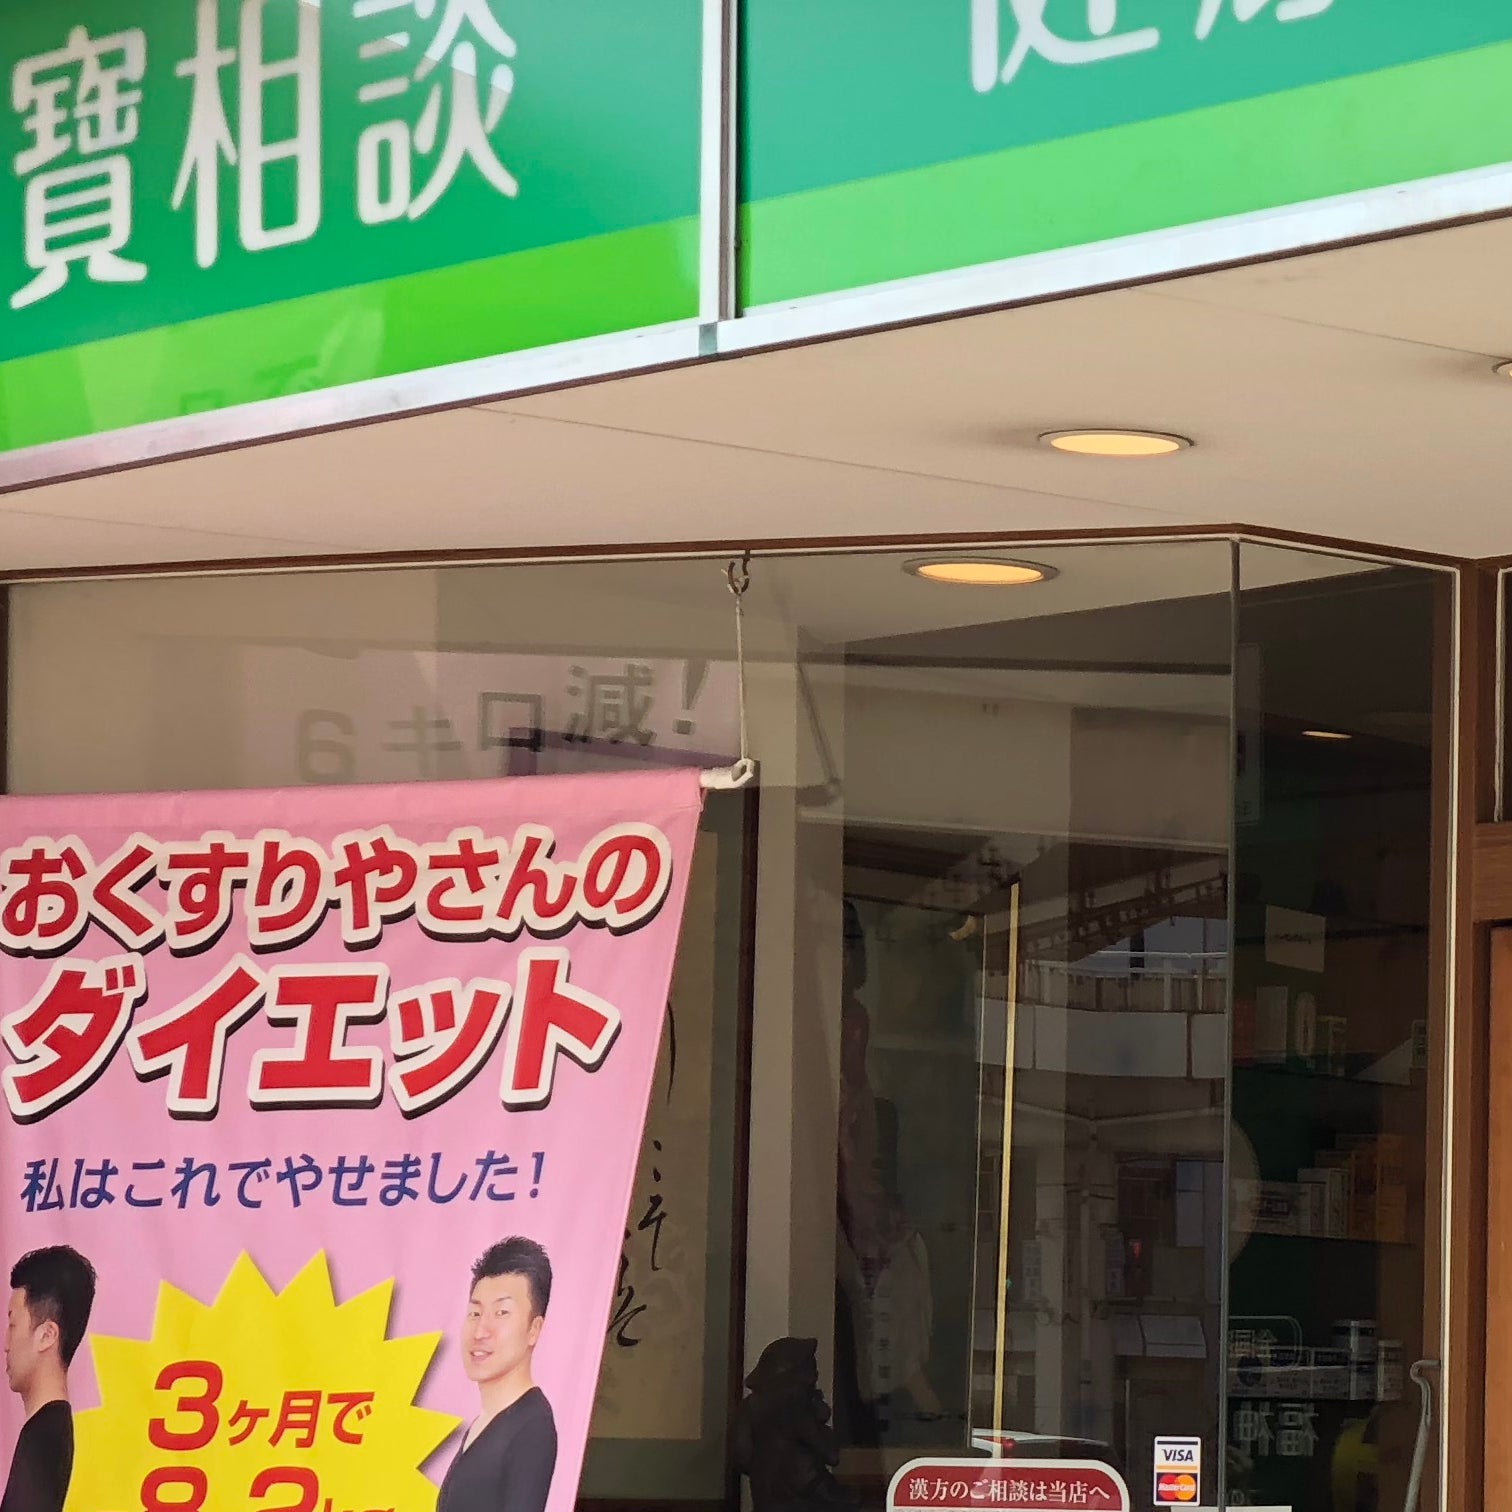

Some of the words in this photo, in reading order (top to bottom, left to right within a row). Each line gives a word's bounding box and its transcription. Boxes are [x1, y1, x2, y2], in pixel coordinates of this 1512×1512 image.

[0, 828, 670, 954] おくすりやさんの
[4, 948, 622, 1122] ダイエット
[20, 1150, 546, 1214] 私はこれでやせました!
[147, 1360, 375, 1451] 3ヶ月で
[909, 1477, 1111, 1504] 漢方のご相談は当店へ
[1163, 1449, 1194, 1462] VISA
